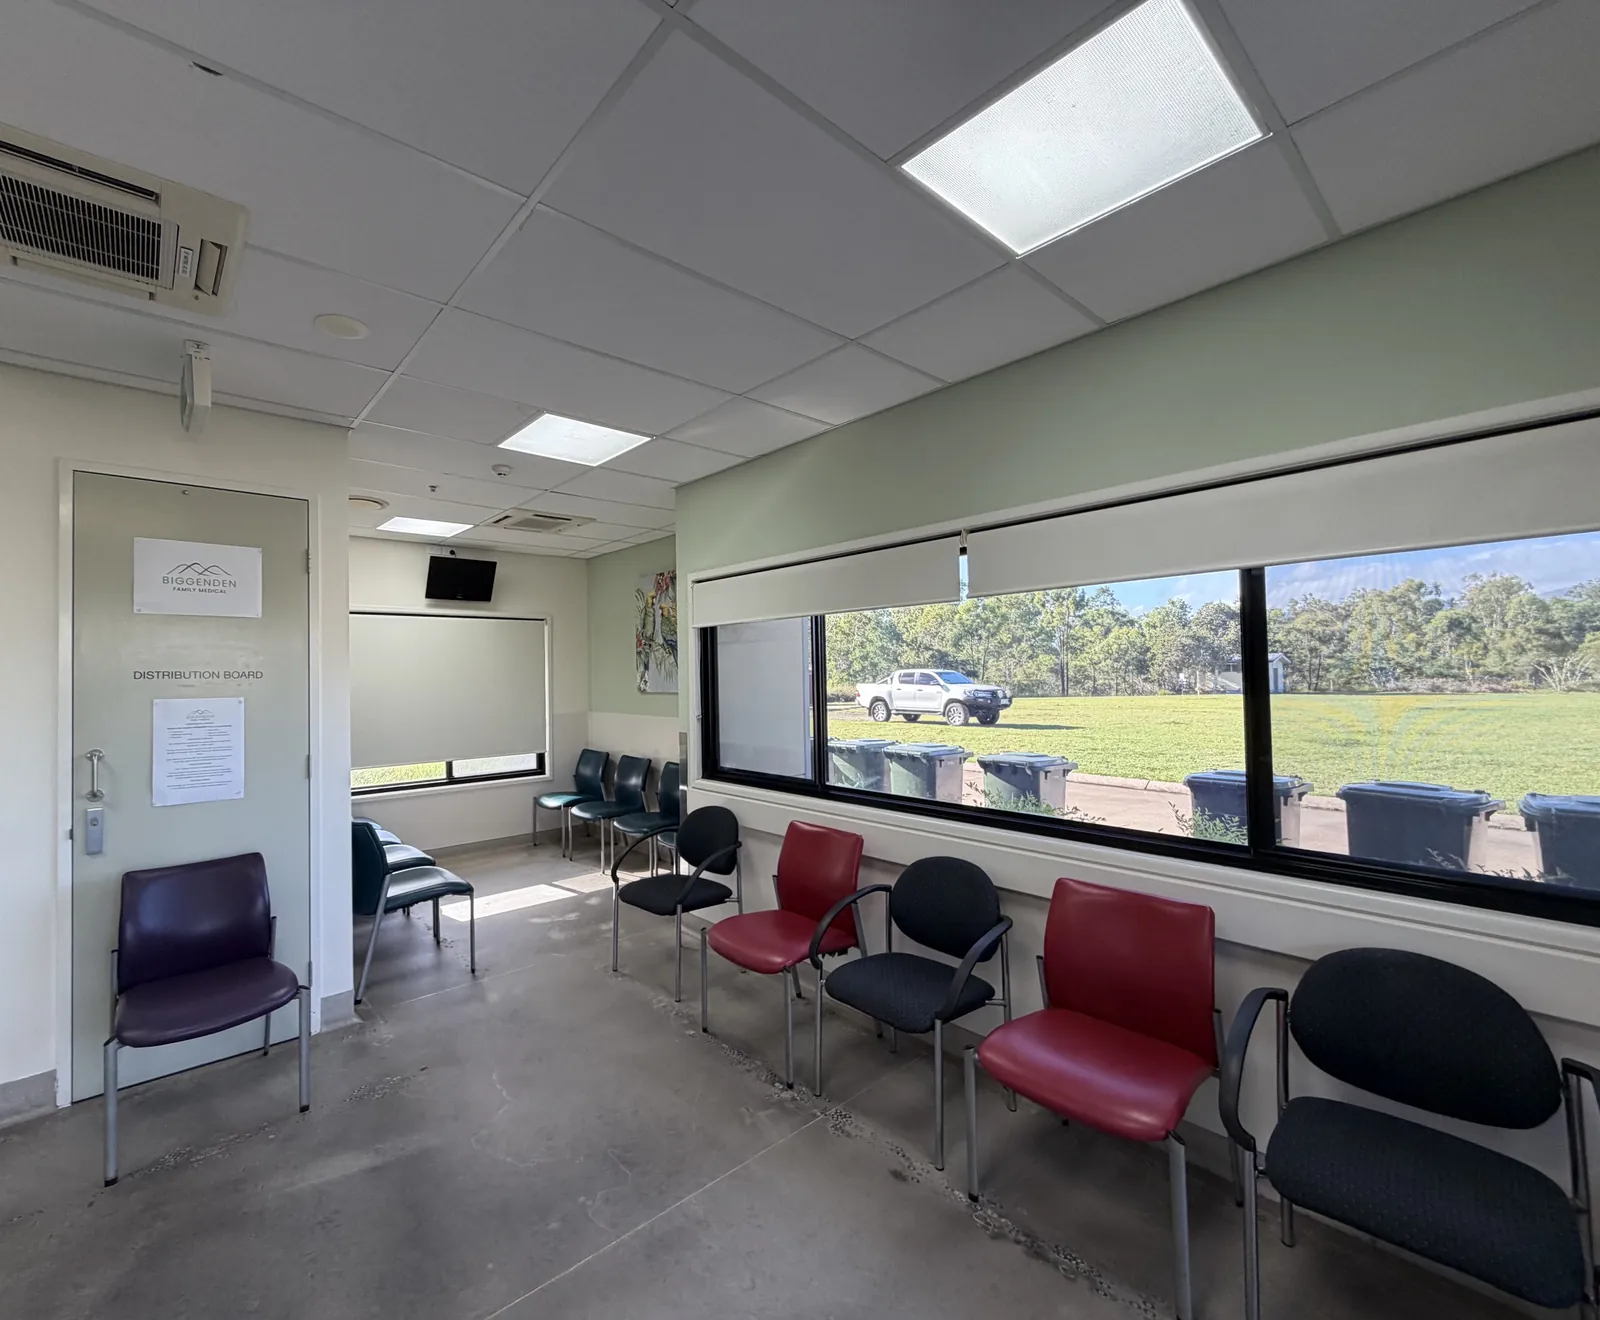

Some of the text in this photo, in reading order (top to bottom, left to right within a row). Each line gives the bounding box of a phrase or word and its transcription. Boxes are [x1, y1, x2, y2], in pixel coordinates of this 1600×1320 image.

[162, 576, 237, 588] BIGGENDEN
[133, 670, 264, 680] DISTRIBUTION BOARD
